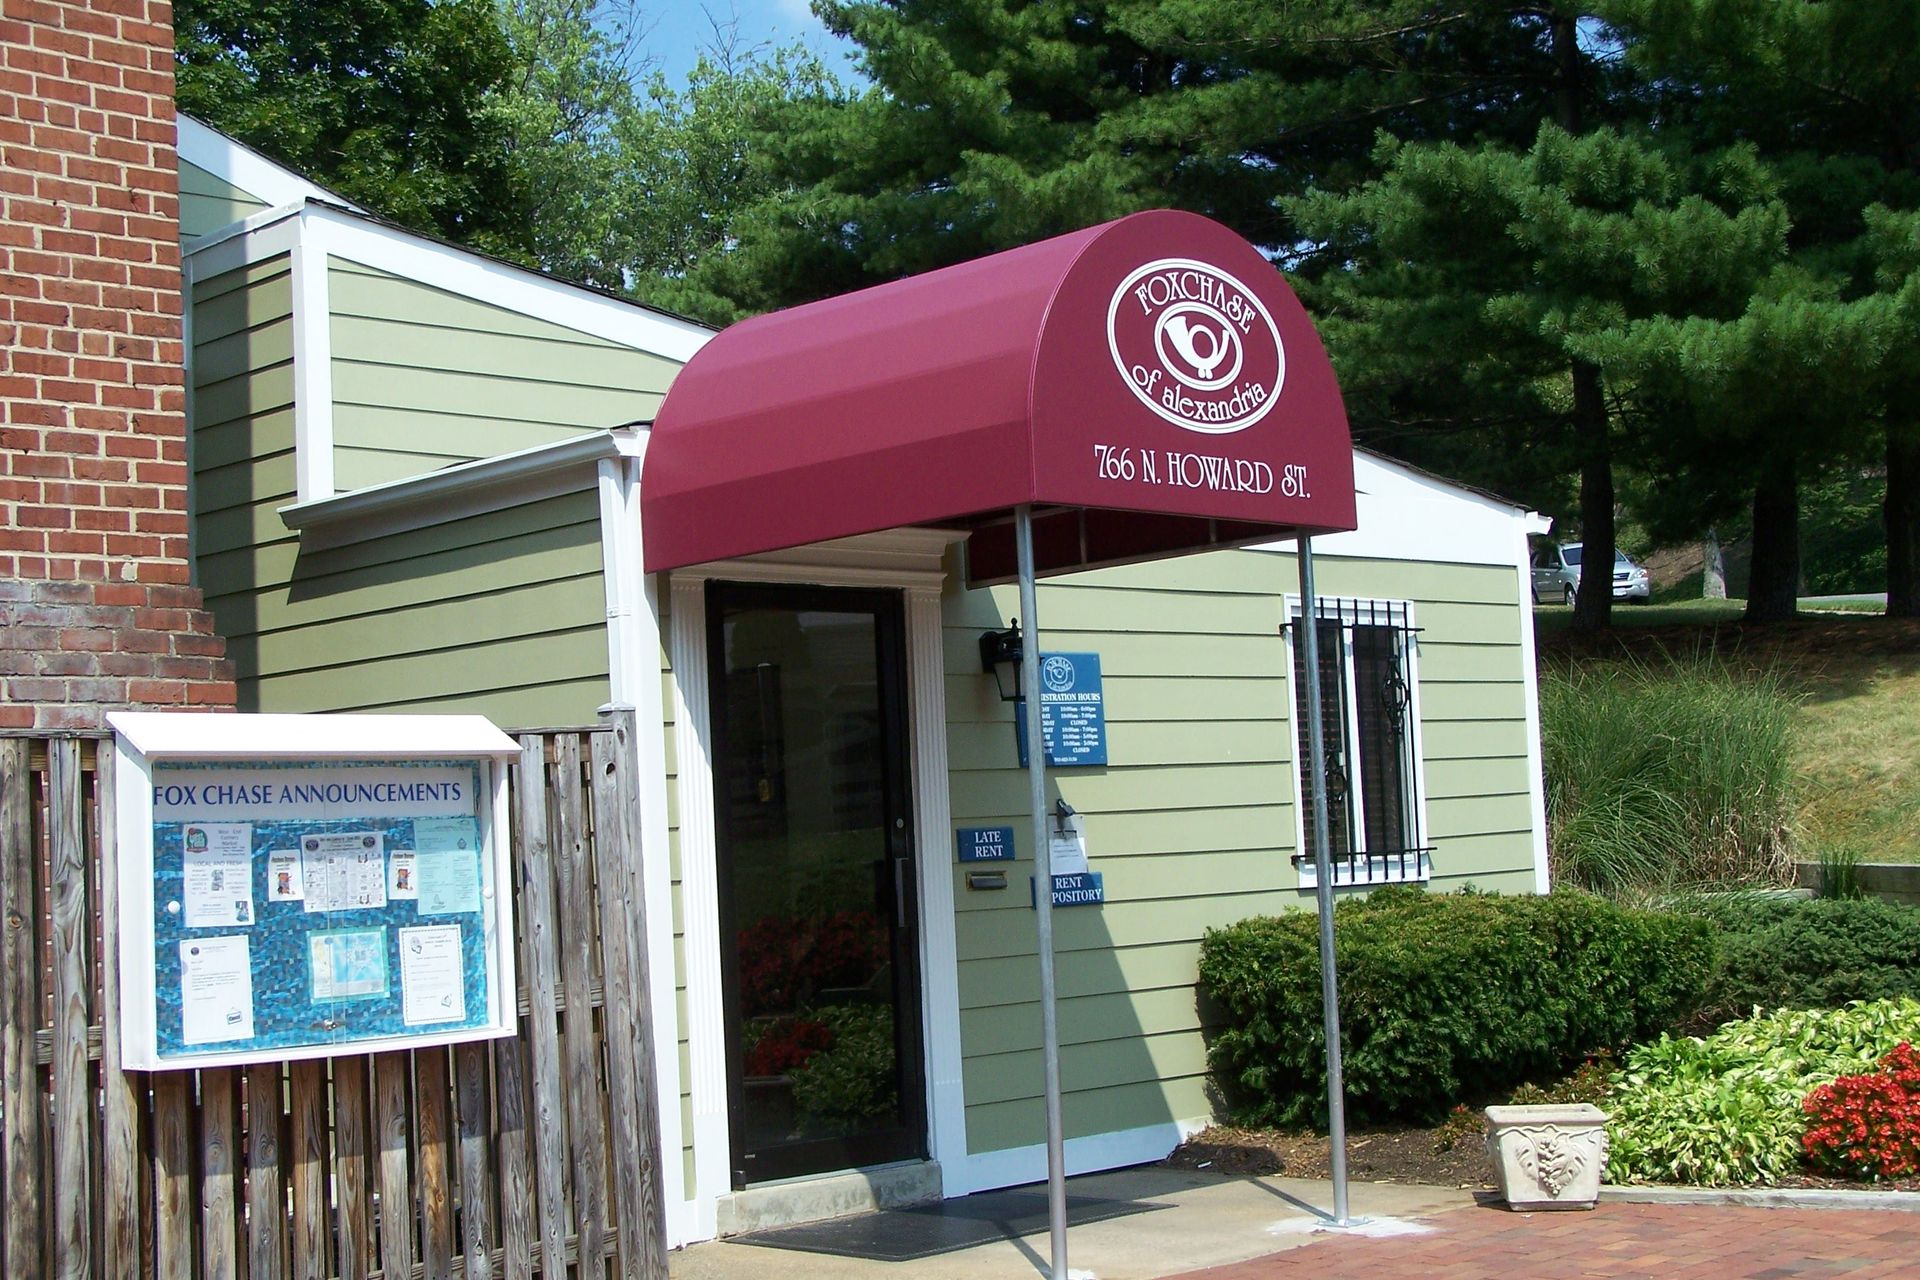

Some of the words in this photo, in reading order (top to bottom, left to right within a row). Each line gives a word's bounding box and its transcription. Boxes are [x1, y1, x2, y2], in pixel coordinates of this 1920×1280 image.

[1135, 271, 1256, 334] FOXCHASE
[1162, 382, 1268, 422] alexandria
[1094, 444, 1135, 481] 766
[1141, 449, 1162, 485] N.
[1167, 452, 1273, 494] HOWARD
[1281, 464, 1312, 498] ST.
[1041, 693, 1077, 701] ISTRATION
[1078, 693, 1101, 701] HOURS
[153, 785, 197, 806] FOX
[202, 784, 273, 805] CHASE
[279, 782, 462, 804] ANNOUNCEMENTS
[975, 831, 1002, 843] LATE
[975, 845, 1004, 858] RENT
[1055, 876, 1082, 889] RENT
[1052, 888, 1102, 904] POSITORY
